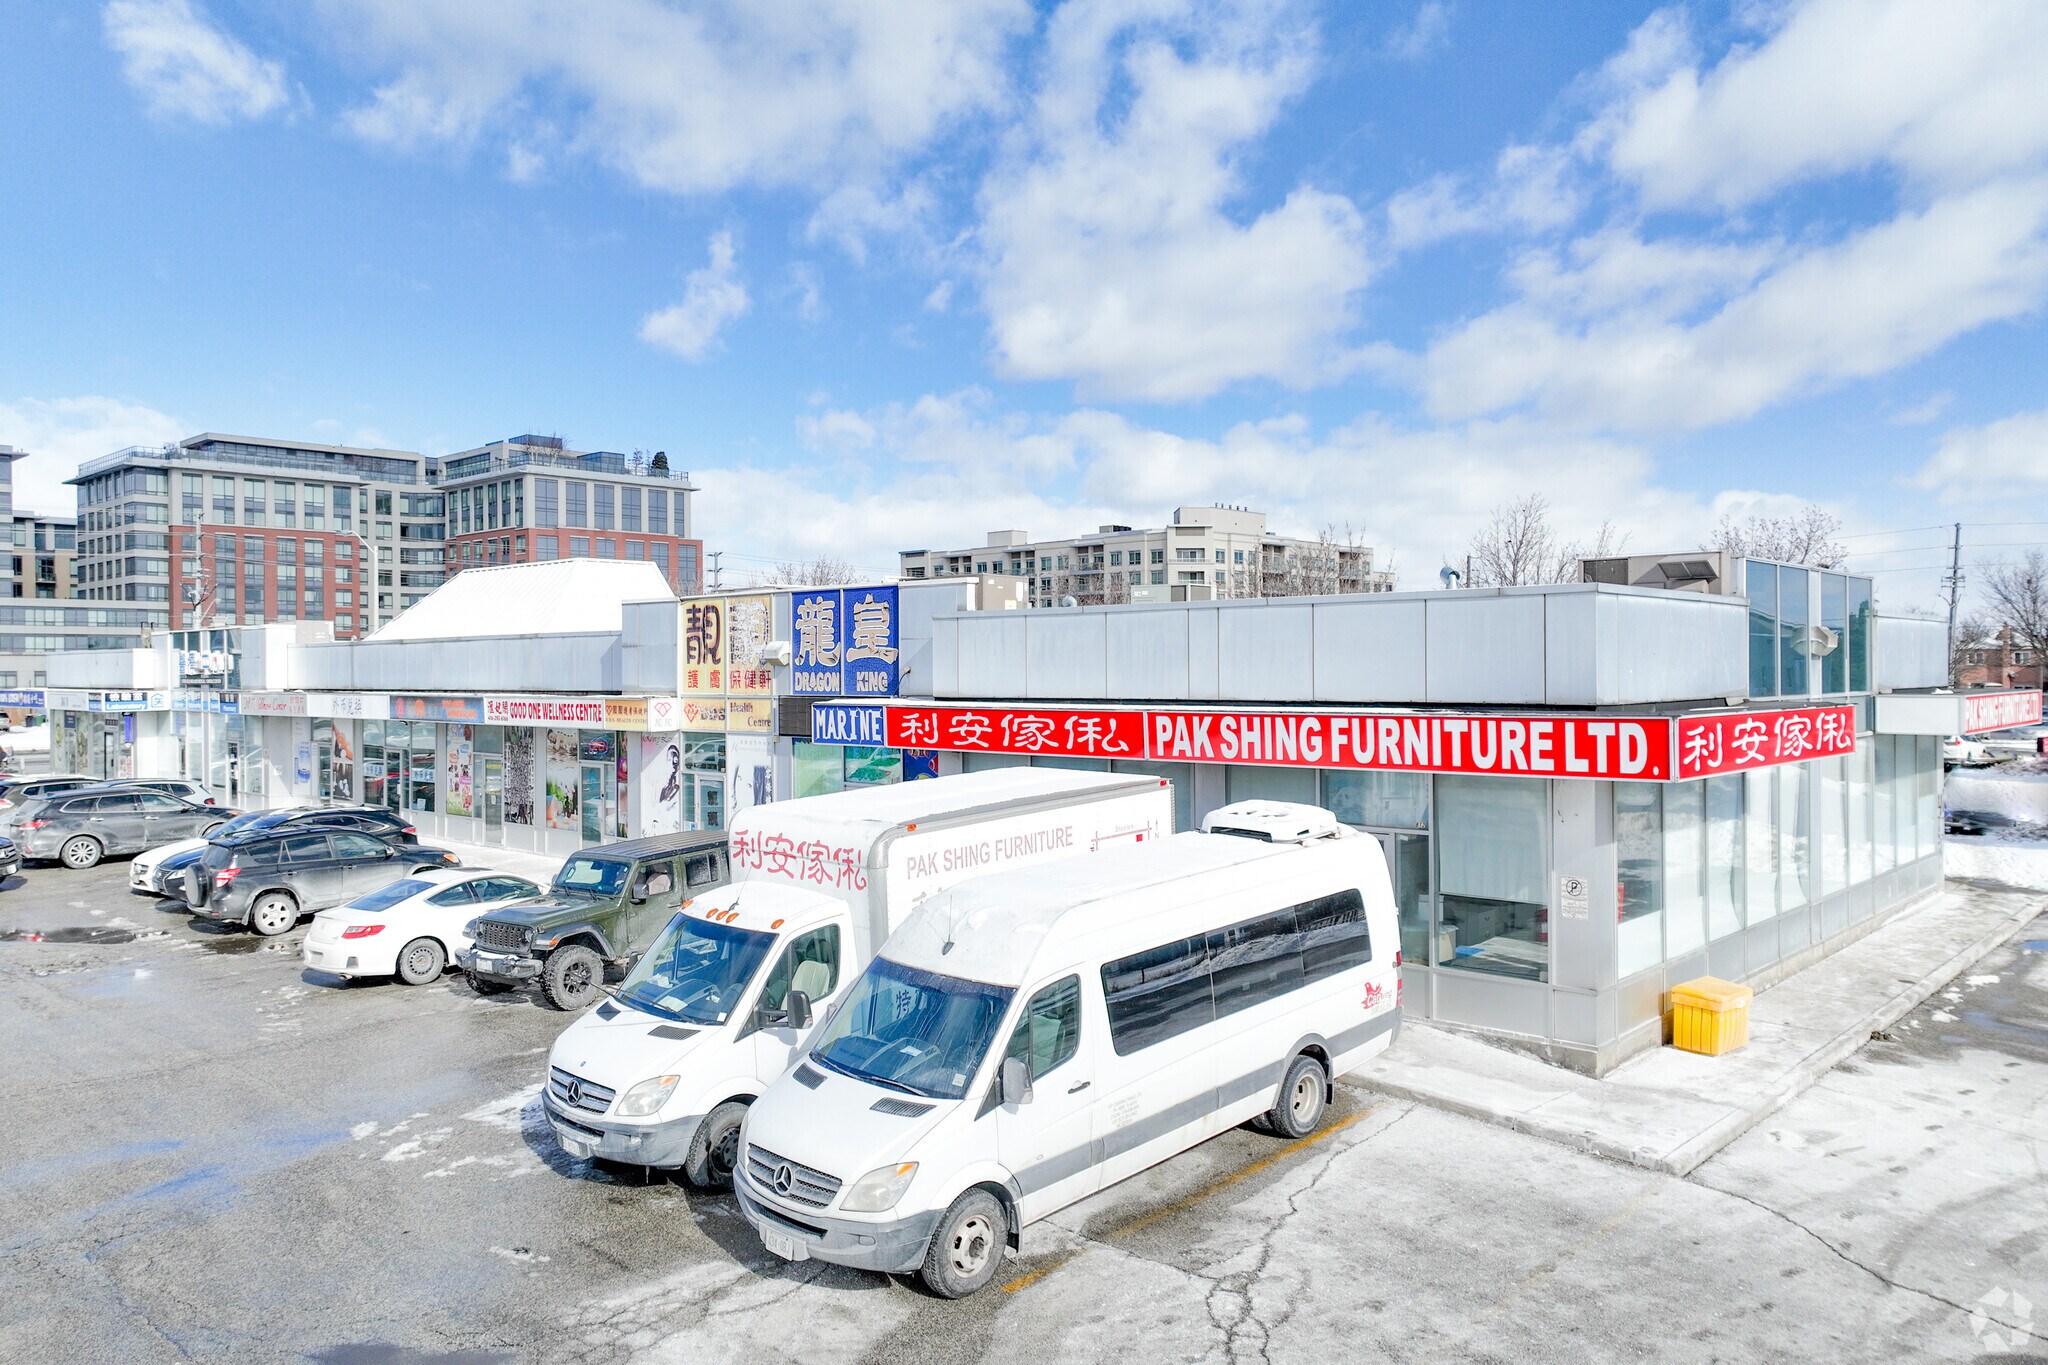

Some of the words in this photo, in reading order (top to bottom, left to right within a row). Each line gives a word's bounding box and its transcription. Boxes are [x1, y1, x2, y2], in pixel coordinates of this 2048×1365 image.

[794, 592, 899, 667] 龍皇
[794, 671, 840, 692] DRAGON
[856, 671, 888, 692] KING
[106, 702, 146, 710] Laboratory
[510, 702, 527, 719] GOOD
[528, 702, 541, 719] ONE
[541, 703, 575, 721] WELLNESS
[576, 703, 602, 723] CENTRE
[730, 702, 753, 713] Health
[747, 716, 772, 727] Centre
[814, 707, 883, 745] MARINE
[900, 711, 1129, 754] 利安傢俬
[1156, 715, 1213, 760] PAK
[1219, 715, 1324, 763] SHING
[1331, 717, 1554, 772] FURNITURE
[1565, 722, 1661, 776] LTD.
[1683, 710, 1853, 772] 利安傢俬
[732, 829, 868, 892] 利安傢俬
[907, 854, 938, 880] PAK
[943, 842, 991, 873] SHING
[994, 825, 1075, 861] FURNITURE
